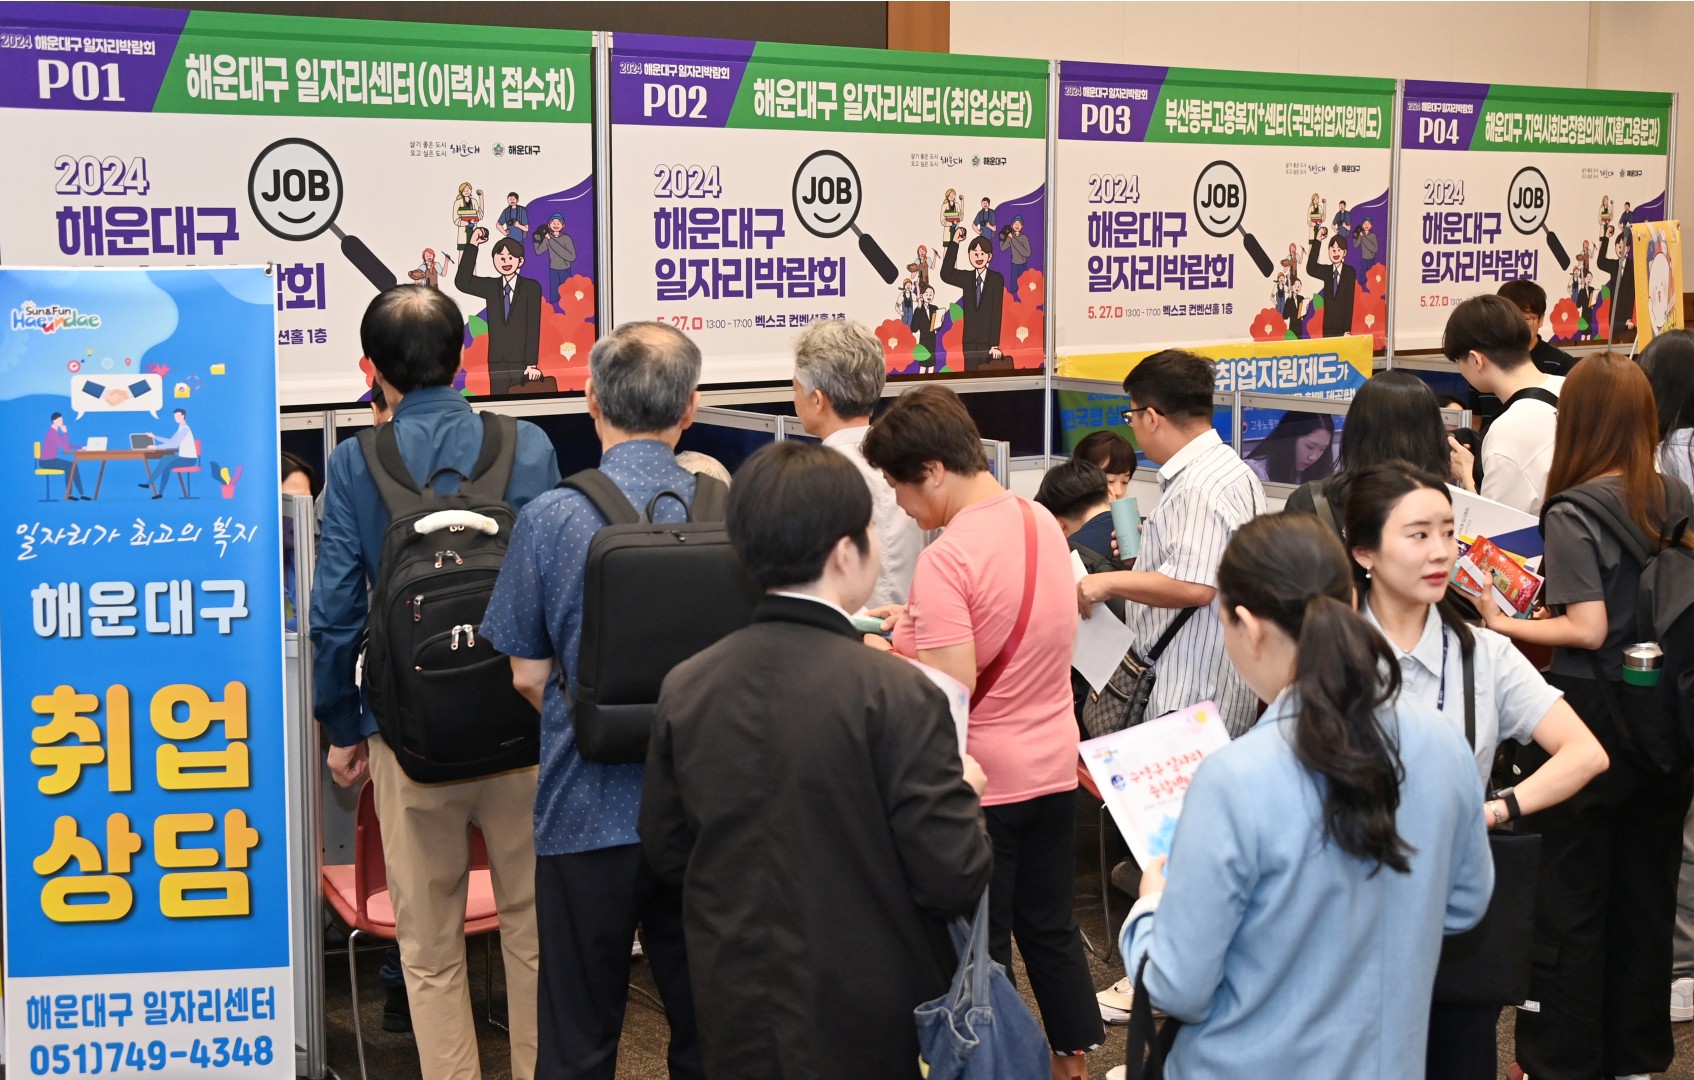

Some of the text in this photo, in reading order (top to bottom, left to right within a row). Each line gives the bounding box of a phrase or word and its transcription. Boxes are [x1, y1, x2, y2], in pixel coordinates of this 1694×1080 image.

[1, 34, 156, 56] 2024 해운대구 일자리박람회
[38, 59, 126, 102] P01
[185, 53, 576, 112] 해운대구 일자리센터(이력서 접수처)
[620, 62, 730, 80] 2024 해운대구 일자리박람회
[643, 83, 708, 119] P02
[753, 77, 1033, 129] 해운대구 일자리센터(취업상담)
[1081, 103, 1131, 134] P03
[1419, 117, 1459, 144] P04
[1485, 112, 1523, 144] 해운대구
[410, 141, 447, 149] 살기 좋은 도시
[435, 150, 447, 158] 도시
[508, 144, 541, 156] 해운대구
[983, 156, 1007, 166] 해운대구
[54, 154, 150, 196] 2024
[261, 168, 330, 202] JOB
[653, 164, 722, 199] 2024
[802, 176, 852, 205] JOB
[1088, 174, 1140, 203] 2024
[1423, 179, 1464, 205] 2024
[1201, 183, 1240, 209] JOB
[1513, 187, 1544, 209] JOB
[56, 205, 240, 256] 해운대구
[654, 207, 785, 250] 해운대구
[1088, 211, 1187, 249] 해운대구
[1422, 211, 1501, 245] 해운대구
[655, 256, 846, 301] 일자리박람회
[1088, 253, 1234, 293] 일자리박람회
[1421, 249, 1538, 284] 일자리박람회
[26, 306, 71, 316] Sun&Fun
[706, 319, 726, 329] 13:00
[733, 318, 752, 329] 17:00
[755, 314, 786, 329] 벡스코
[1088, 306, 1097, 319] 5.
[1100, 305, 1113, 319] 27.
[1125, 308, 1141, 317] 13:00
[1146, 308, 1160, 317] 17:00
[1163, 304, 1187, 317] 벡스코
[1189, 303, 1220, 316] 컨벤션홀
[1222, 303, 1233, 315] 1층
[307, 328, 327, 344] 1층
[16, 516, 258, 561] 일자리가 최고의 복지
[30, 579, 249, 637] 해운대구
[29, 680, 251, 795] 취업
[33, 808, 260, 922] 상담
[26, 985, 276, 1030] 해운대구 일자리센터
[30, 1035, 274, 1077] 051)749-4348
